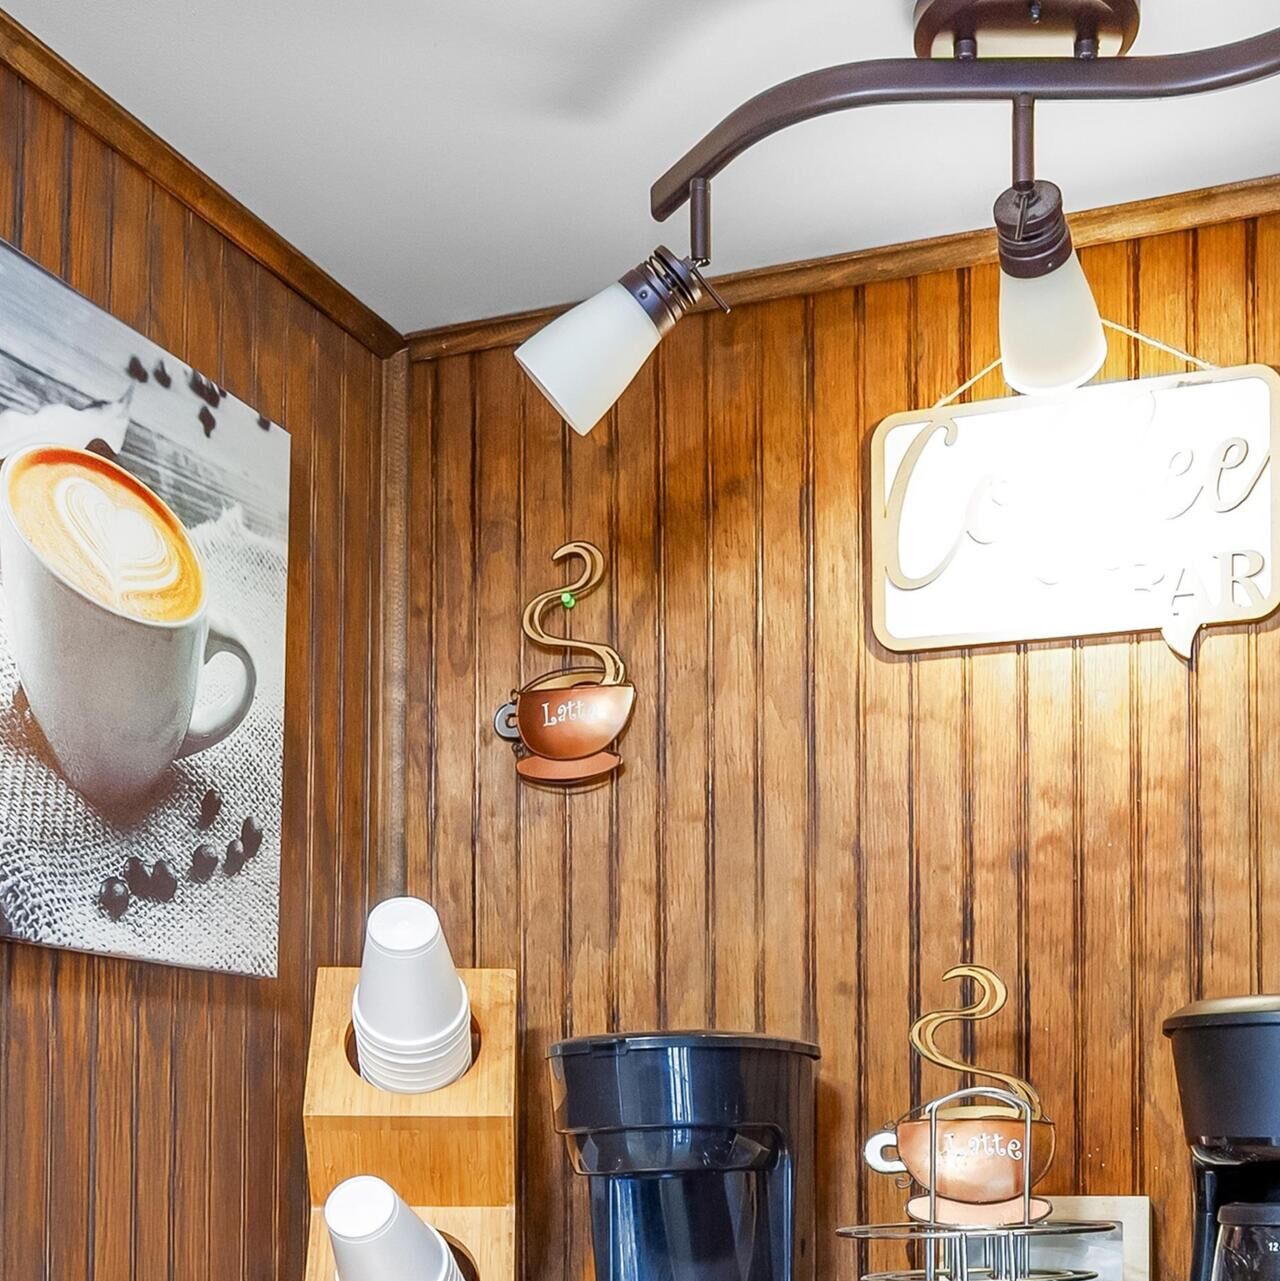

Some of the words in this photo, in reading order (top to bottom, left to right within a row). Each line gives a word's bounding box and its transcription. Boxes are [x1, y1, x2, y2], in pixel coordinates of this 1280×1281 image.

[884, 388, 1272, 590] Coee
[541, 699, 602, 728] Latt
[939, 1131, 1023, 1161] Latte
[1268, 1242, 1279, 1251] 12
